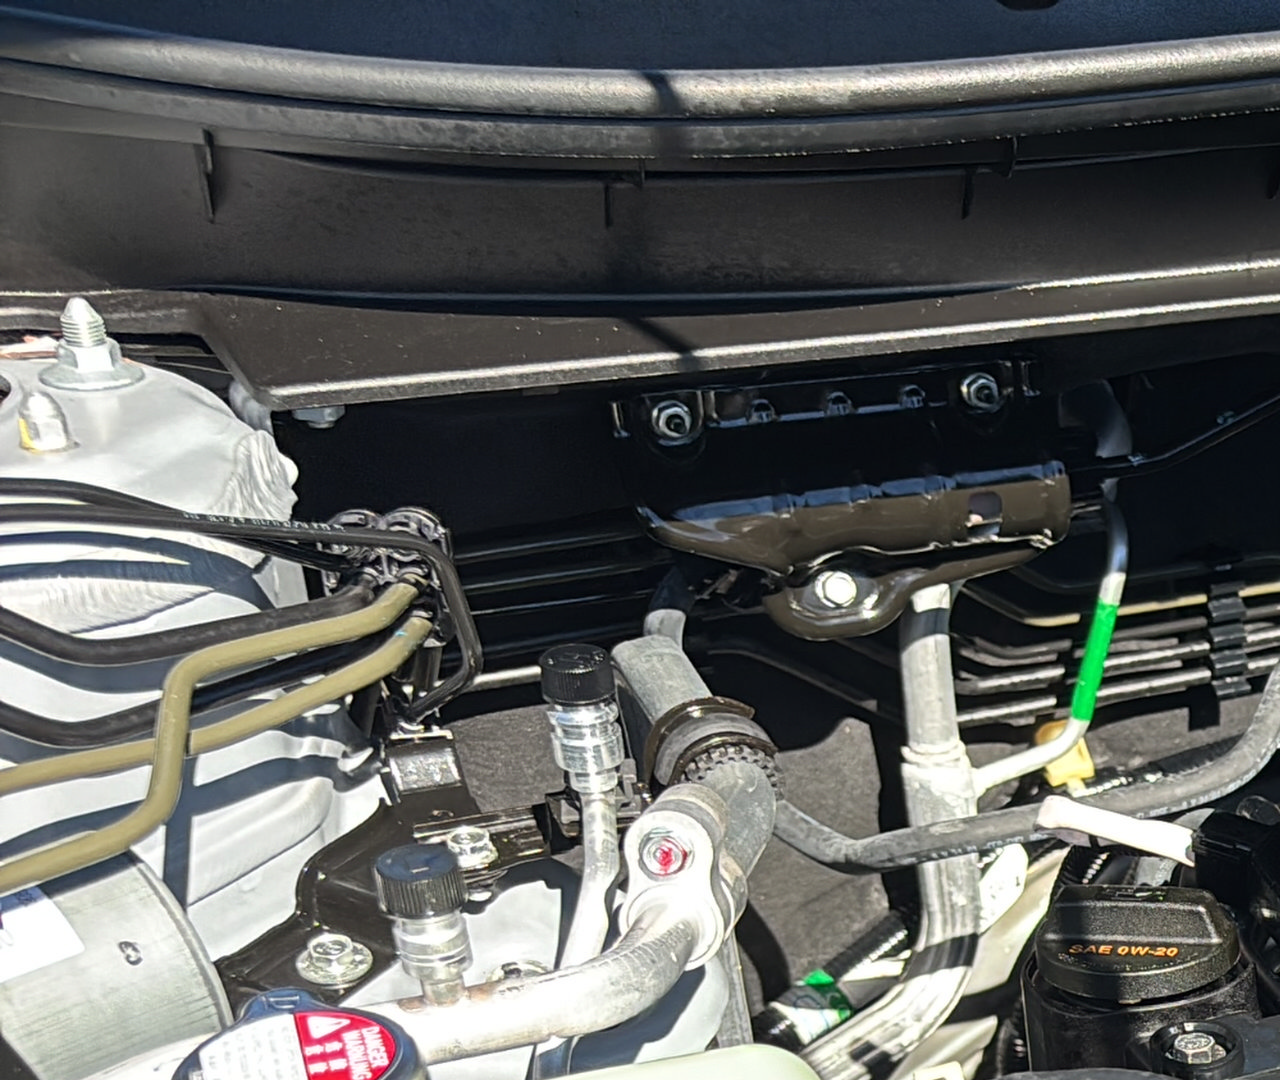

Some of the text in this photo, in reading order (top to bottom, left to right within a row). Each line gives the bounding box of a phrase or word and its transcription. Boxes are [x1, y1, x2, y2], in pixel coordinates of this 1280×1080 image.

[1068, 944, 1178, 957] SAE 0W-20
[361, 1026, 389, 1068] DANGER
